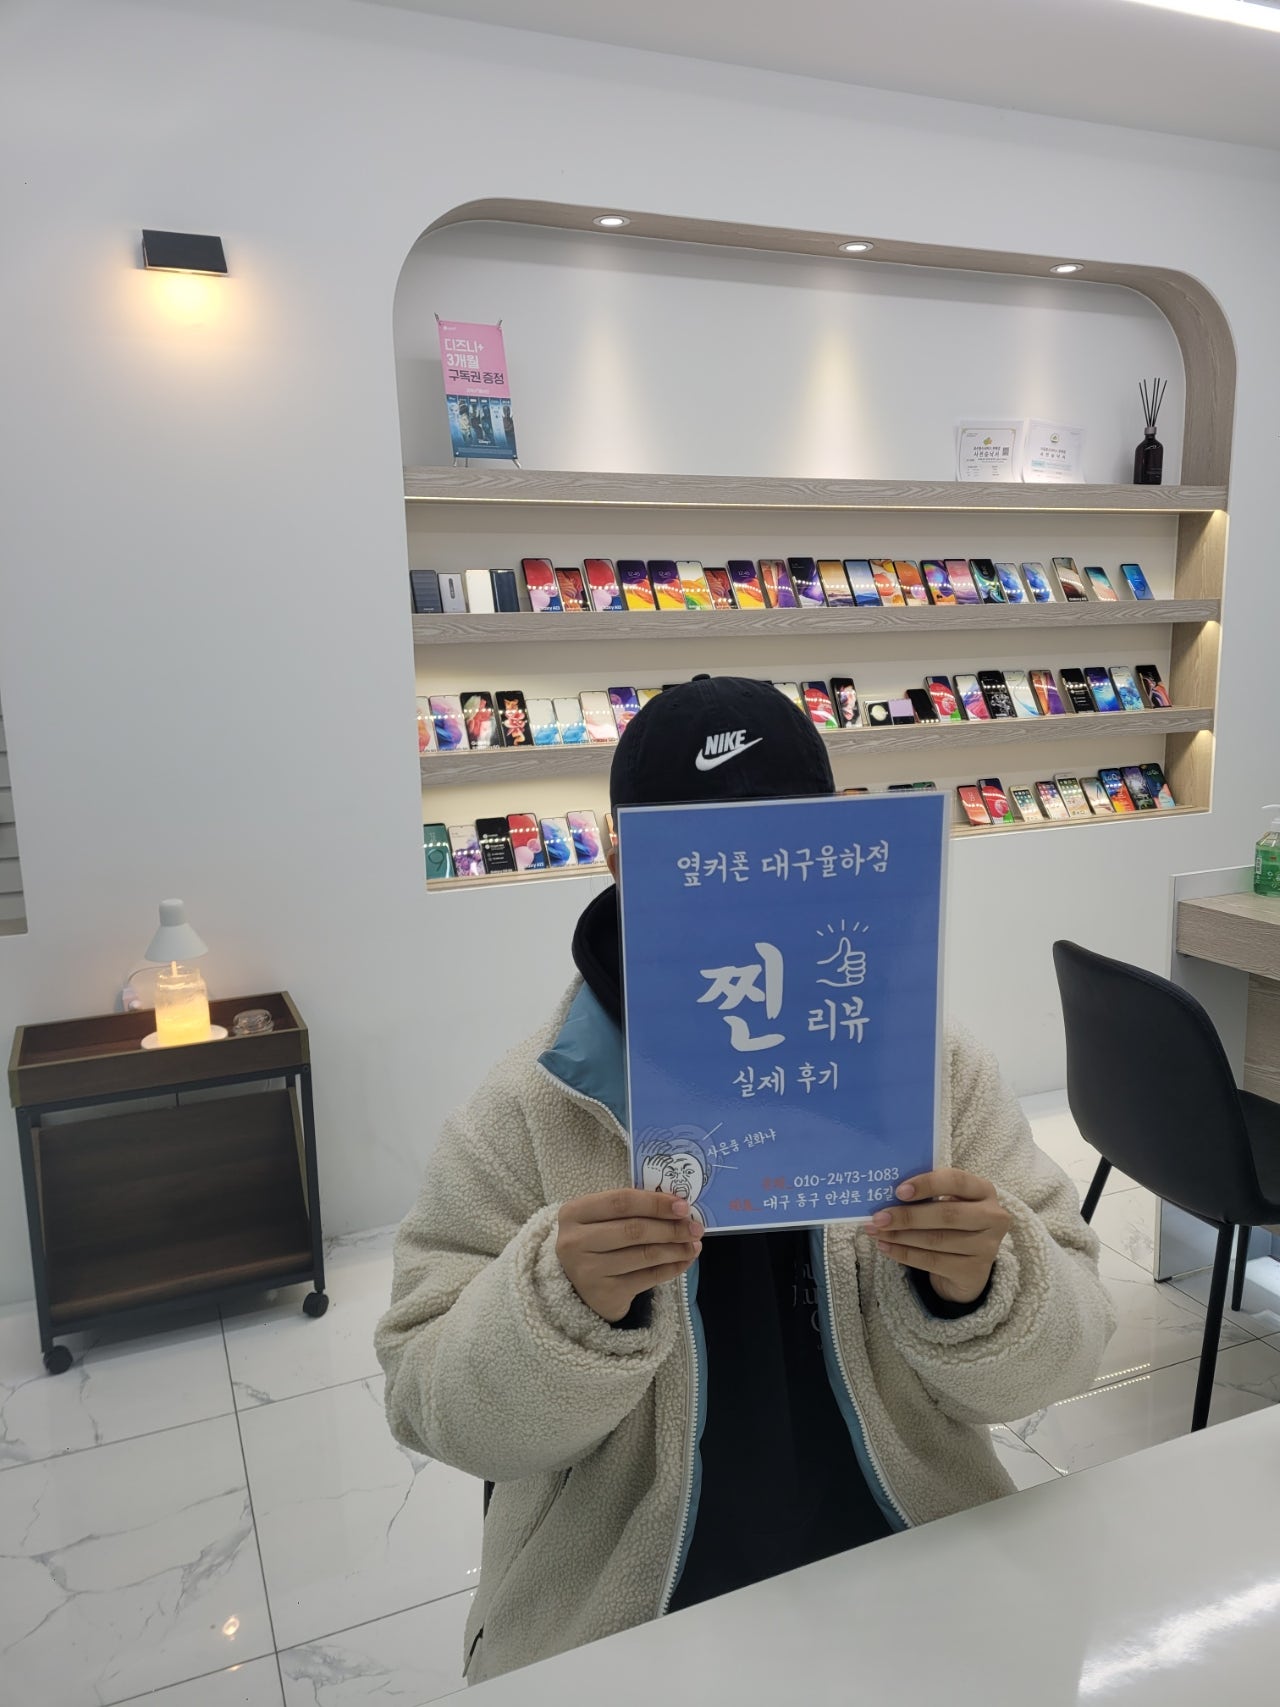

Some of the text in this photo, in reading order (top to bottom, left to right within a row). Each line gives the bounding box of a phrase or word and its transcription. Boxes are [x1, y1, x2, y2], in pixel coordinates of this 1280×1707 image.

[444, 338, 484, 353] 디즈니+
[446, 353, 480, 369] 3개월
[448, 369, 505, 385] 구독권 증정
[704, 729, 747, 755] NIKE
[677, 840, 889, 887] 옆커폰 대구율하점
[696, 942, 786, 1052] 찐
[807, 996, 870, 1043] 리뷰
[732, 1062, 838, 1097] 실제 후기
[744, 1128, 776, 1148] 실화냐
[794, 1167, 899, 1188] 010-2473-1083
[763, 1195, 790, 1211] 대구
[795, 1192, 820, 1208] 동구
[825, 1190, 862, 1205] 안심로
[867, 1185, 894, 1201] 16길
